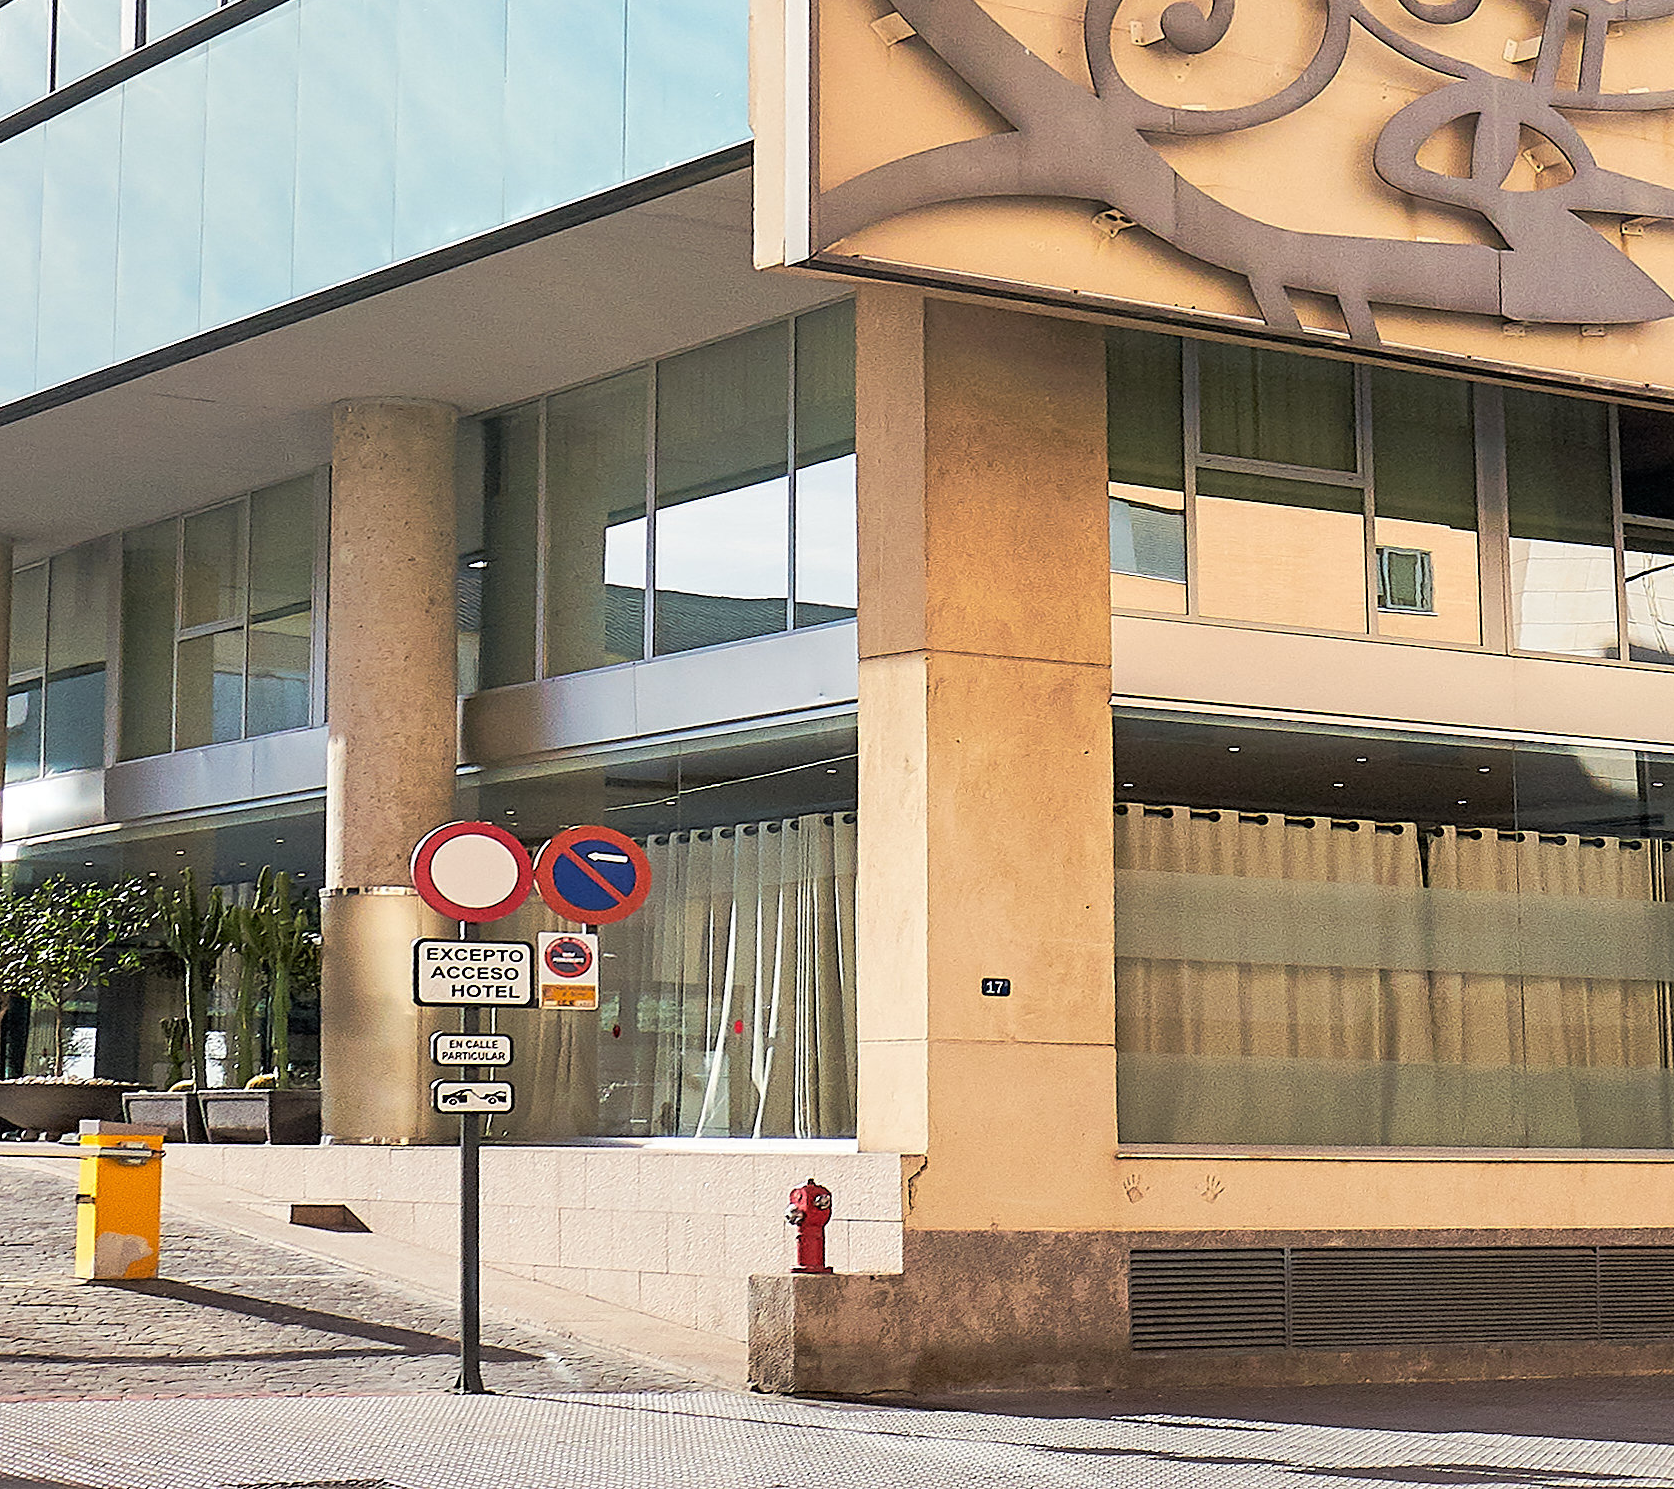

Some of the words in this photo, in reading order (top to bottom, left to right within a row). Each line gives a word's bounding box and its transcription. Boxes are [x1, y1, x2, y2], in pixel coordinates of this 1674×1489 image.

[426, 947, 524, 963] EXCEPTO
[430, 966, 519, 981] ACCESO
[451, 984, 521, 999] HOTEL
[449, 1040, 463, 1049] EN
[466, 1040, 498, 1049] CALLE
[442, 1051, 506, 1061] PARTICULAR
